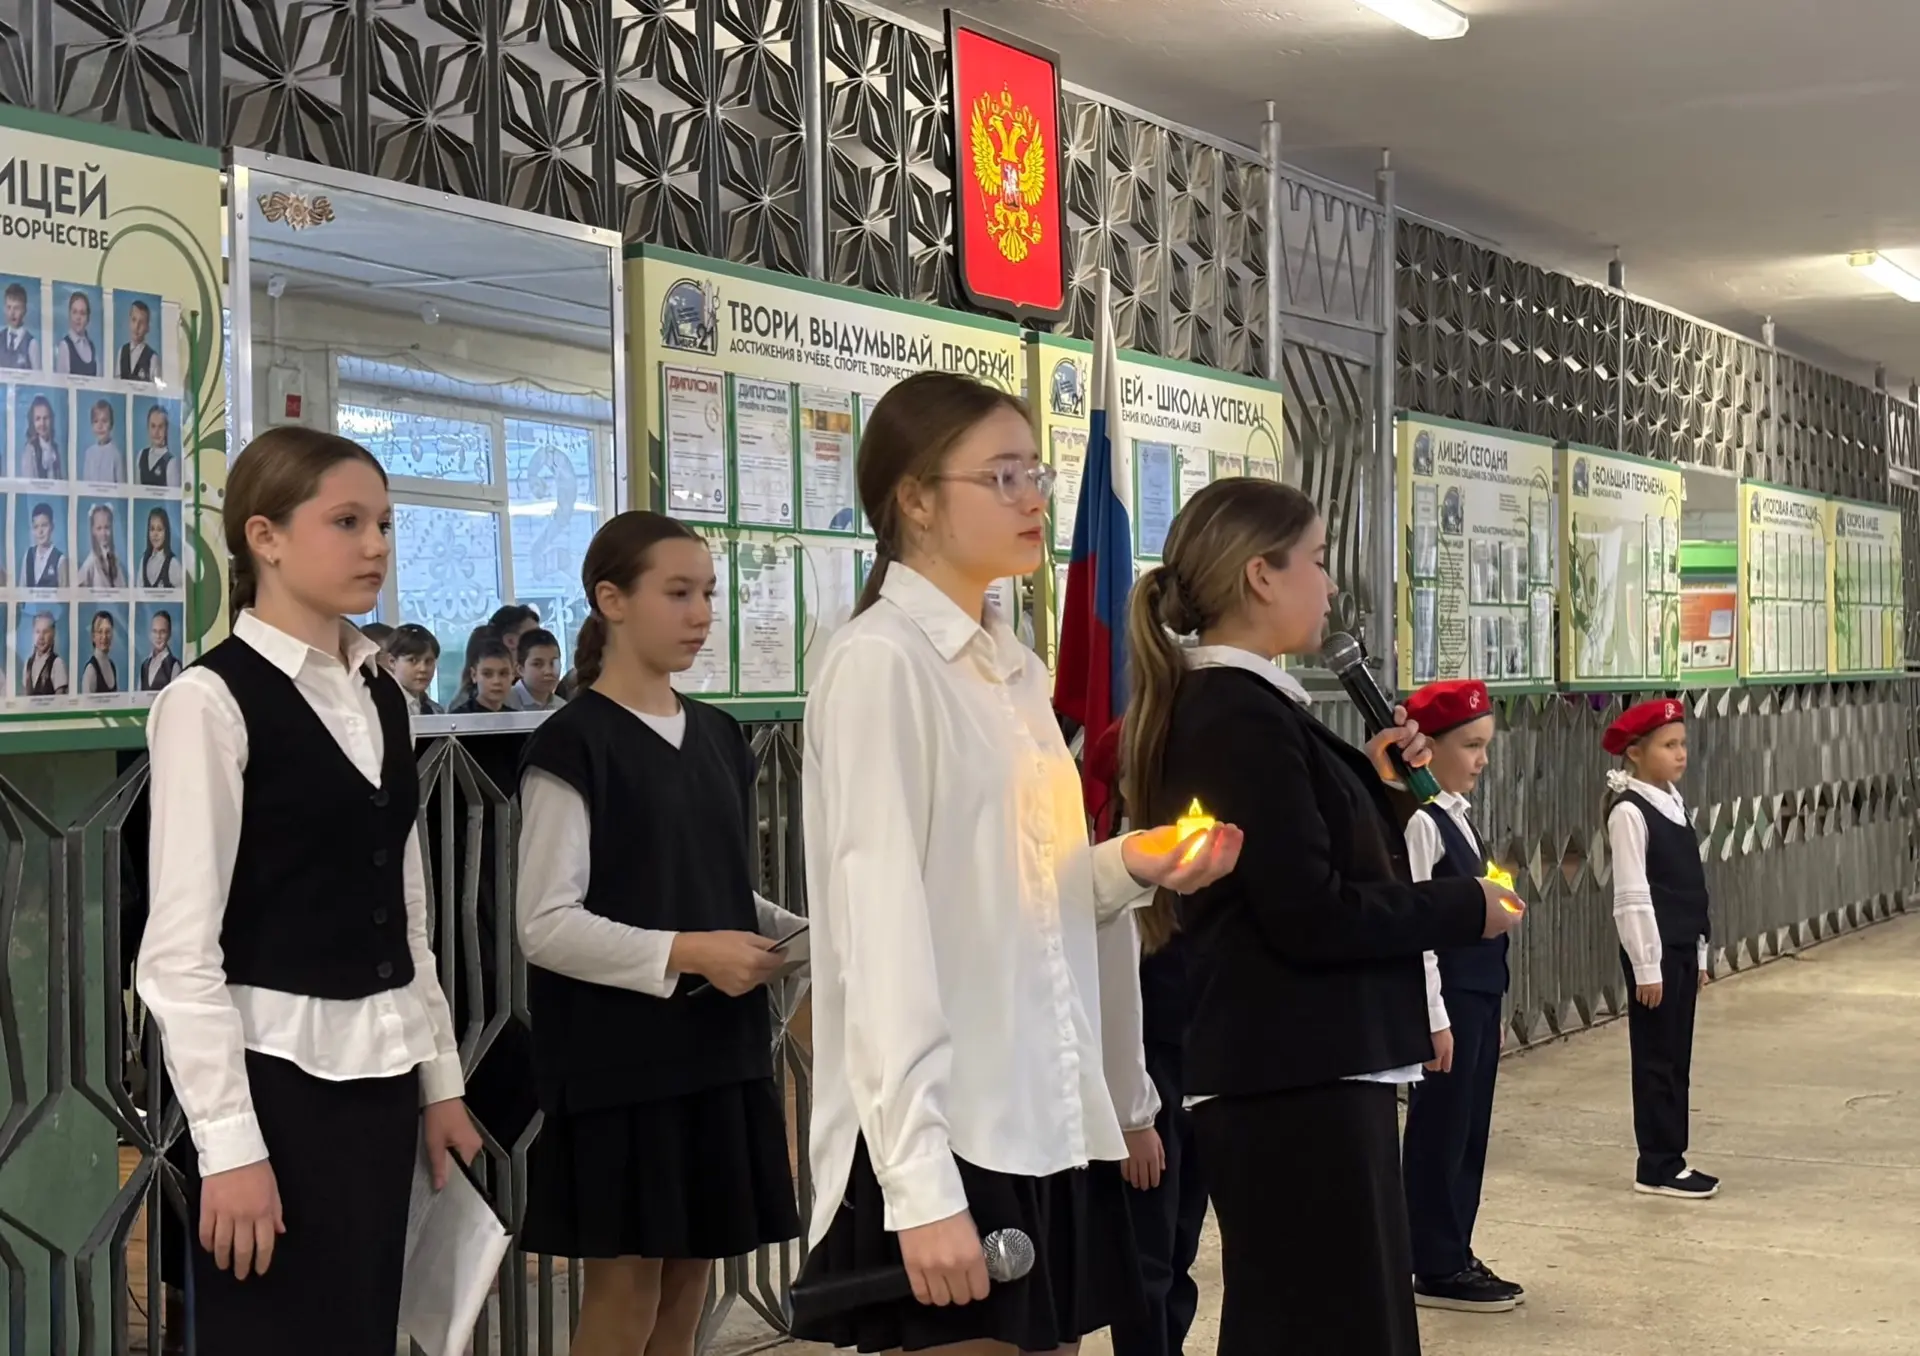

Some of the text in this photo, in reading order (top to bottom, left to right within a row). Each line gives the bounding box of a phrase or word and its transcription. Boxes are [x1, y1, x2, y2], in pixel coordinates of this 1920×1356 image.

[0, 213, 109, 250] ВОРЧЕСТВЕ
[728, 300, 1015, 381] ТВОРИ, ВЫДУМЫВАЙ, ПРОБУЙ!
[730, 338, 795, 361] ДОСТИЖЕНИЯ
[797, 350, 803, 363] В
[803, 350, 834, 370] УЧЁБЕ,
[834, 356, 869, 376] СПОРТЕ,
[669, 376, 718, 394] ДИПЛОМ
[738, 383, 787, 402] ДИПЛОМ
[1140, 412, 1181, 431] КОЛЛЕКТИВА
[1157, 384, 1210, 420] ШКОЛА
[1212, 395, 1264, 428] УСПЕХА!
[1437, 440, 1468, 466] ЛИЦЕЙ
[1470, 445, 1508, 472] СЕГОДНЯ
